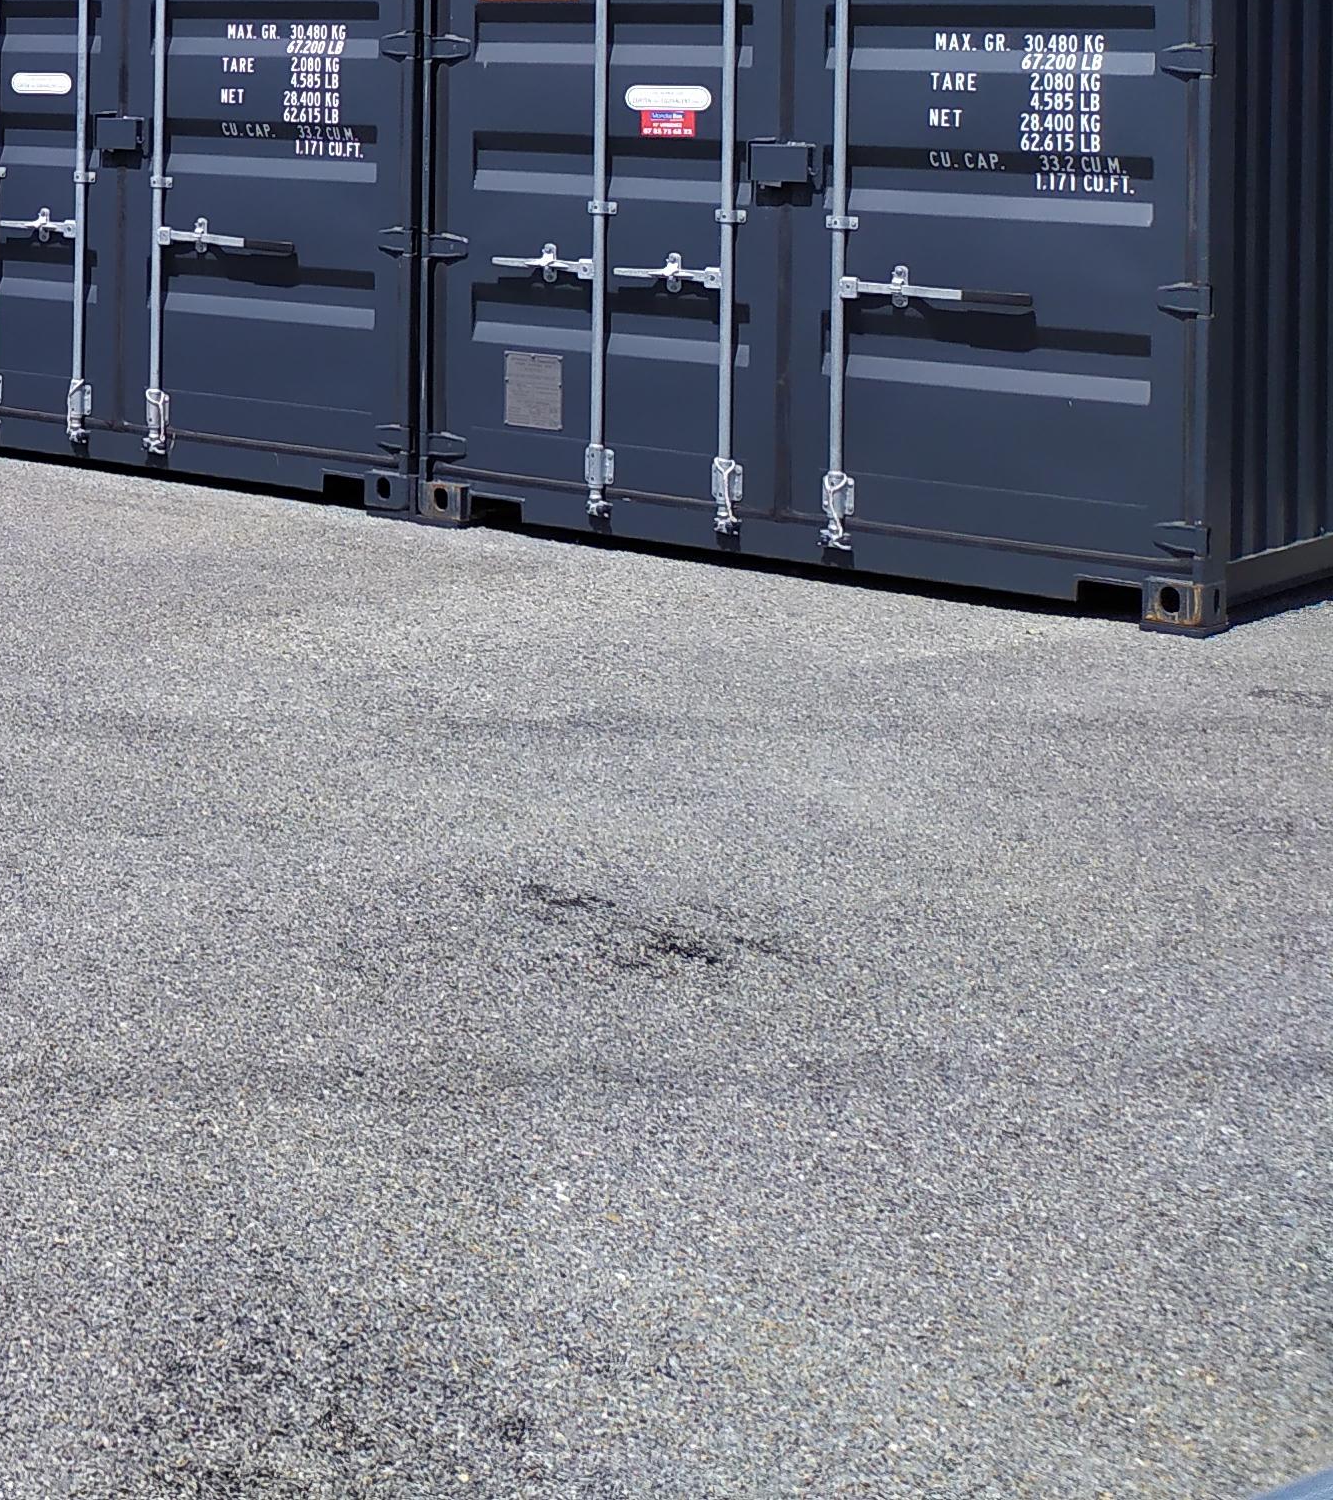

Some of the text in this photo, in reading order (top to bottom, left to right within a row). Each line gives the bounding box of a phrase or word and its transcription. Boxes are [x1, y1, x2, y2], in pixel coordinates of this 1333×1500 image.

[227, 24, 257, 39] MAX.
[261, 24, 280, 39] GR.
[331, 24, 346, 40] KG
[327, 40, 345, 55] LB
[935, 32, 977, 52] MAX.
[984, 33, 1011, 52] GR.
[1084, 34, 1105, 53] KG
[222, 57, 255, 73] TARE
[325, 57, 340, 73] KG
[1081, 53, 1103, 71] LB
[324, 73, 339, 89] LB
[930, 72, 977, 92] TARE
[1080, 73, 1101, 92] KG
[220, 88, 244, 104] NET
[324, 91, 340, 107] KG
[1080, 93, 1100, 112] LB
[324, 108, 339, 124] LB
[929, 108, 963, 127] NET
[1080, 114, 1101, 133] KG
[297, 125, 323, 140] 33.2
[1080, 134, 1101, 153] LB
[929, 151, 959, 168] CU.
[964, 152, 1006, 171] CAP.
[1038, 155, 1076, 172] 33.2
